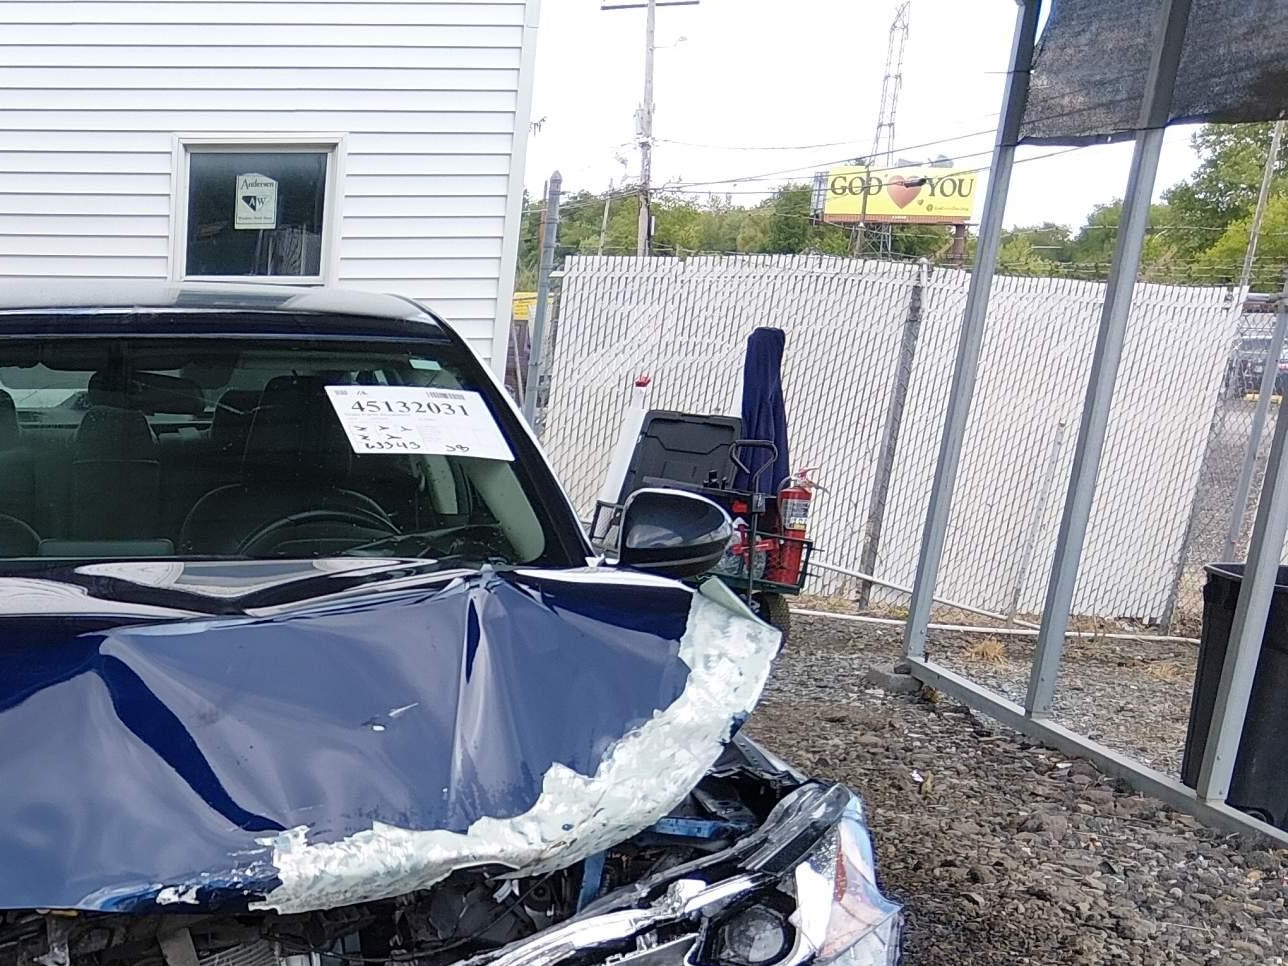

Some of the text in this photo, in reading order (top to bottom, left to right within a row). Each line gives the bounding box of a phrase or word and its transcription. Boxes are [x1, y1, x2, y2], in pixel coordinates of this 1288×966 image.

[830, 175, 974, 198] GOD YOU
[351, 400, 470, 417] 45132031
